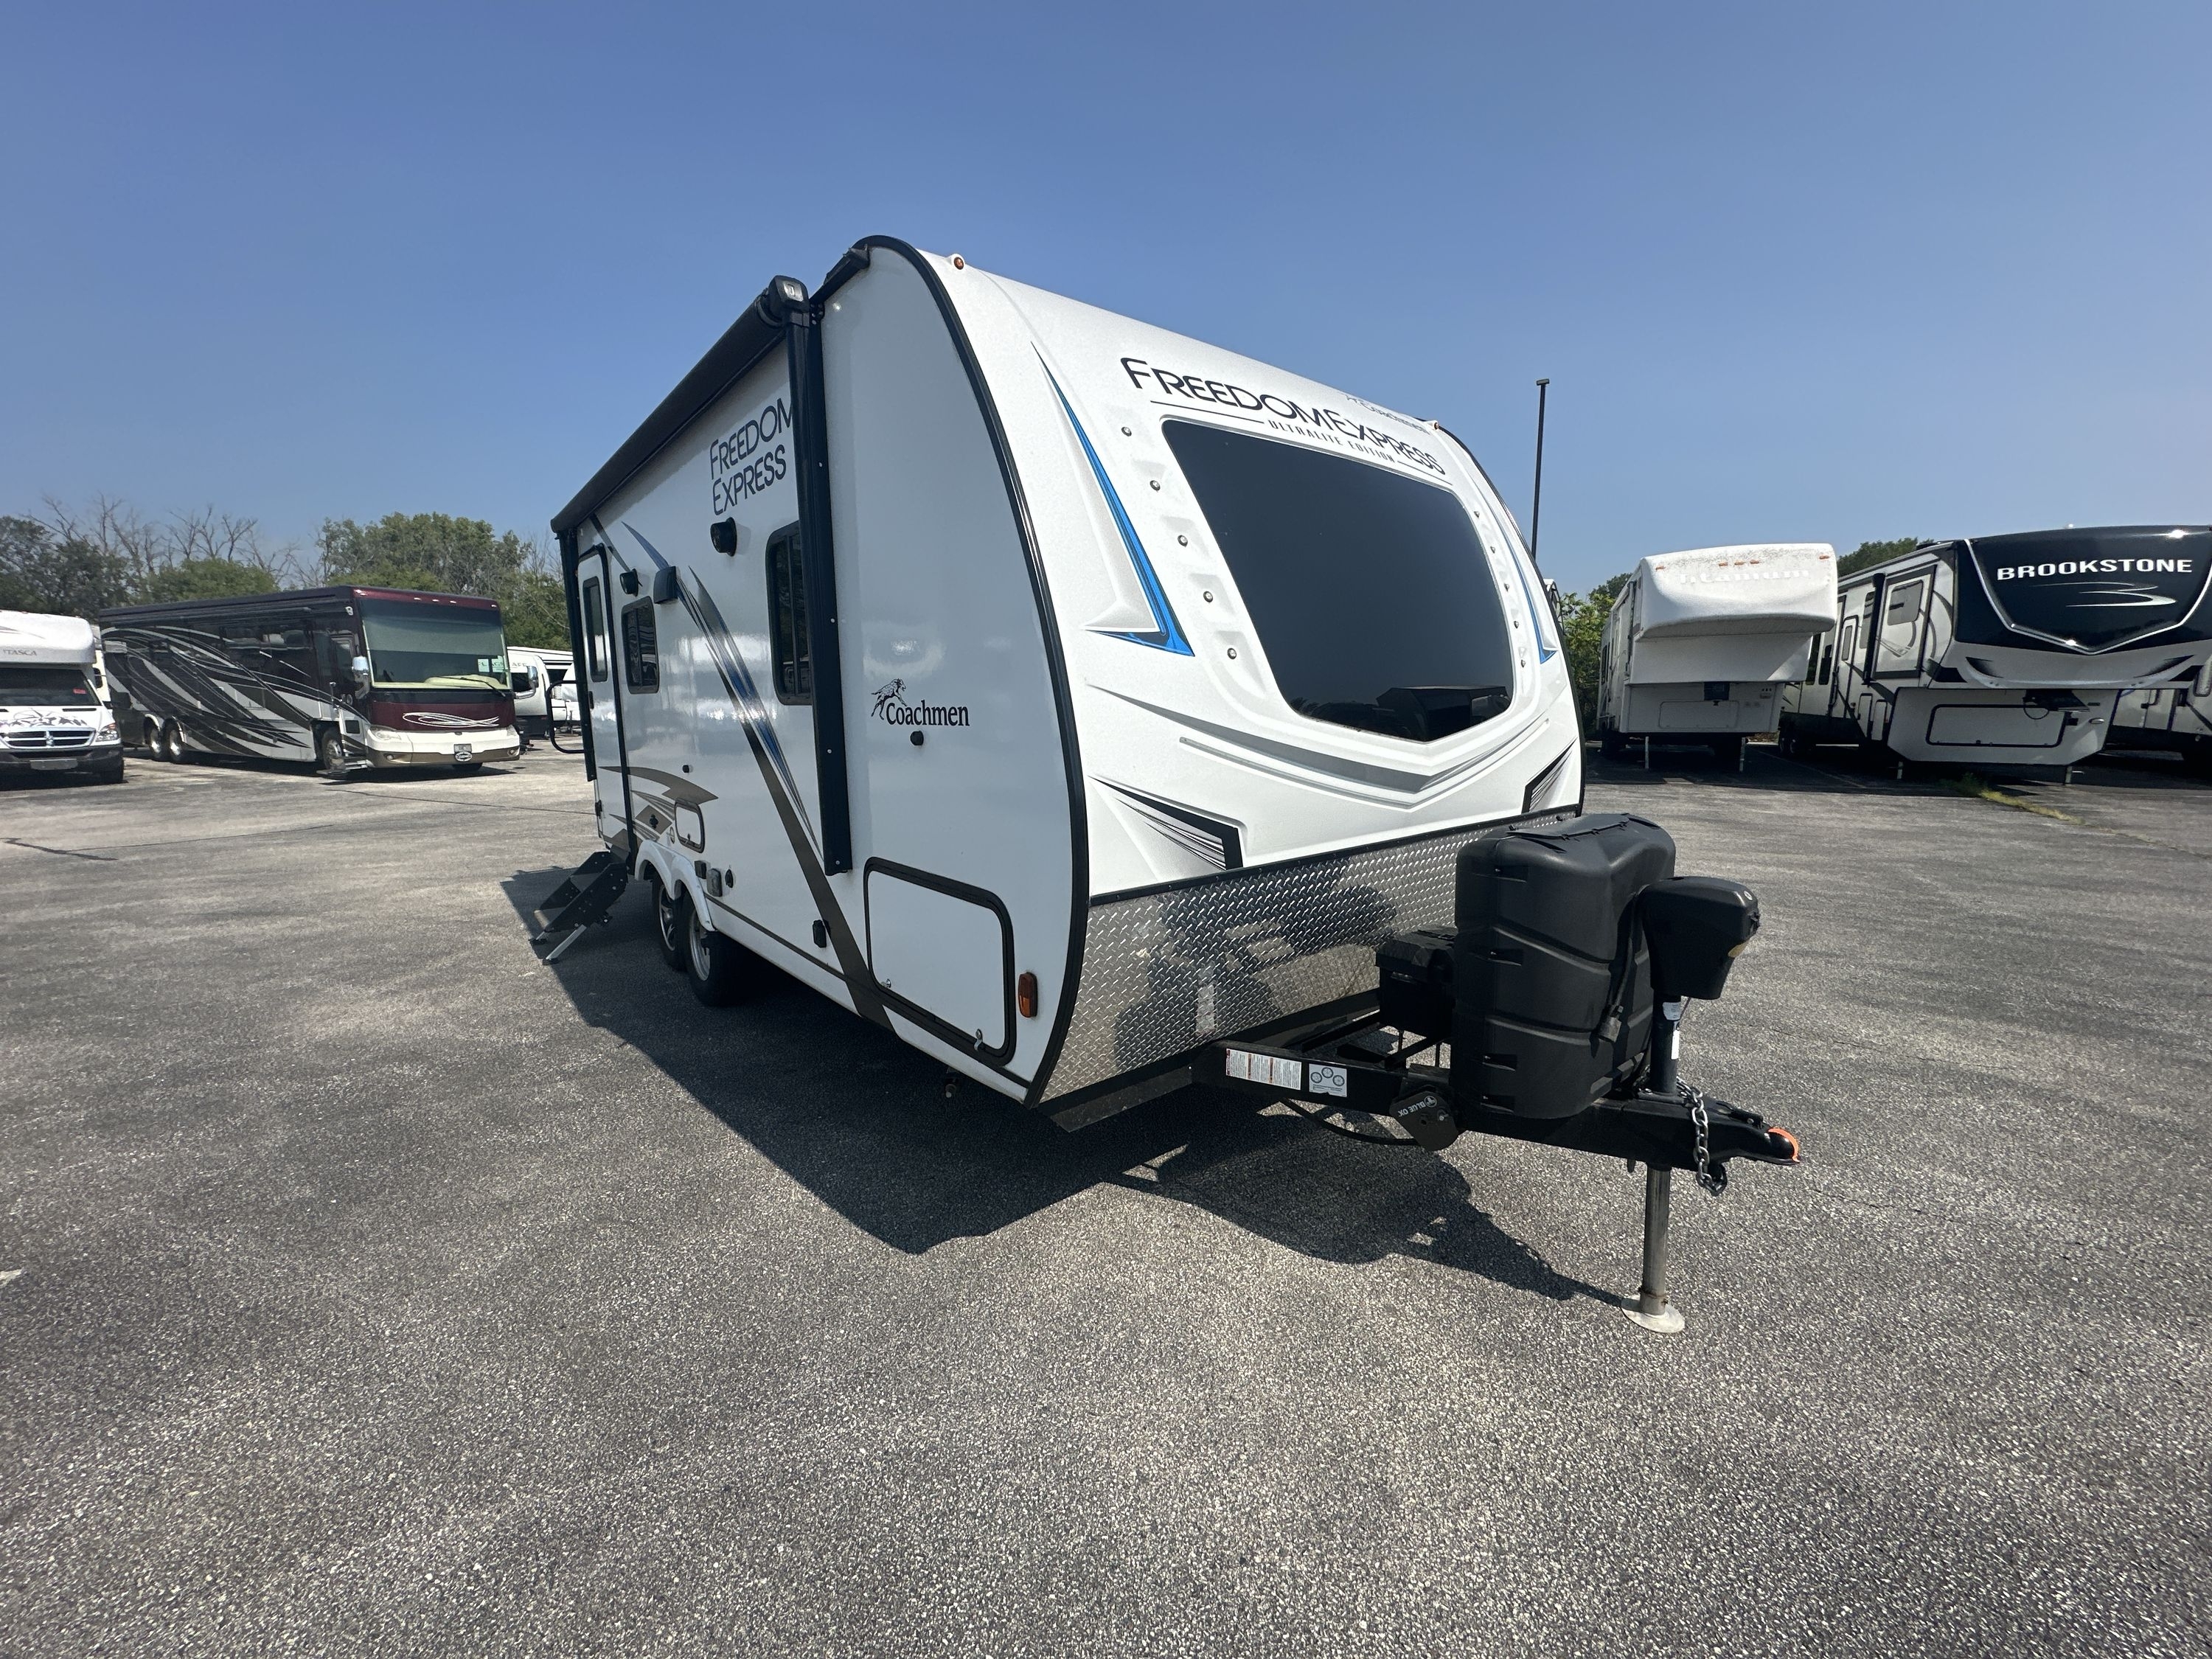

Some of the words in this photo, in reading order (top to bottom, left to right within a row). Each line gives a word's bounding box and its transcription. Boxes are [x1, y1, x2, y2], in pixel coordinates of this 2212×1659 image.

[710, 398, 792, 479] FREEDOM
[1268, 420, 1343, 445] ULTRALITE
[1348, 439, 1395, 463] EDITION
[713, 445, 786, 515] EXPRESS
[1997, 559, 2193, 581] BROOKSTONE
[886, 700, 970, 726] Coachmen
[1397, 1108, 1409, 1118] OX
[1408, 1101, 1427, 1113] BLUE
